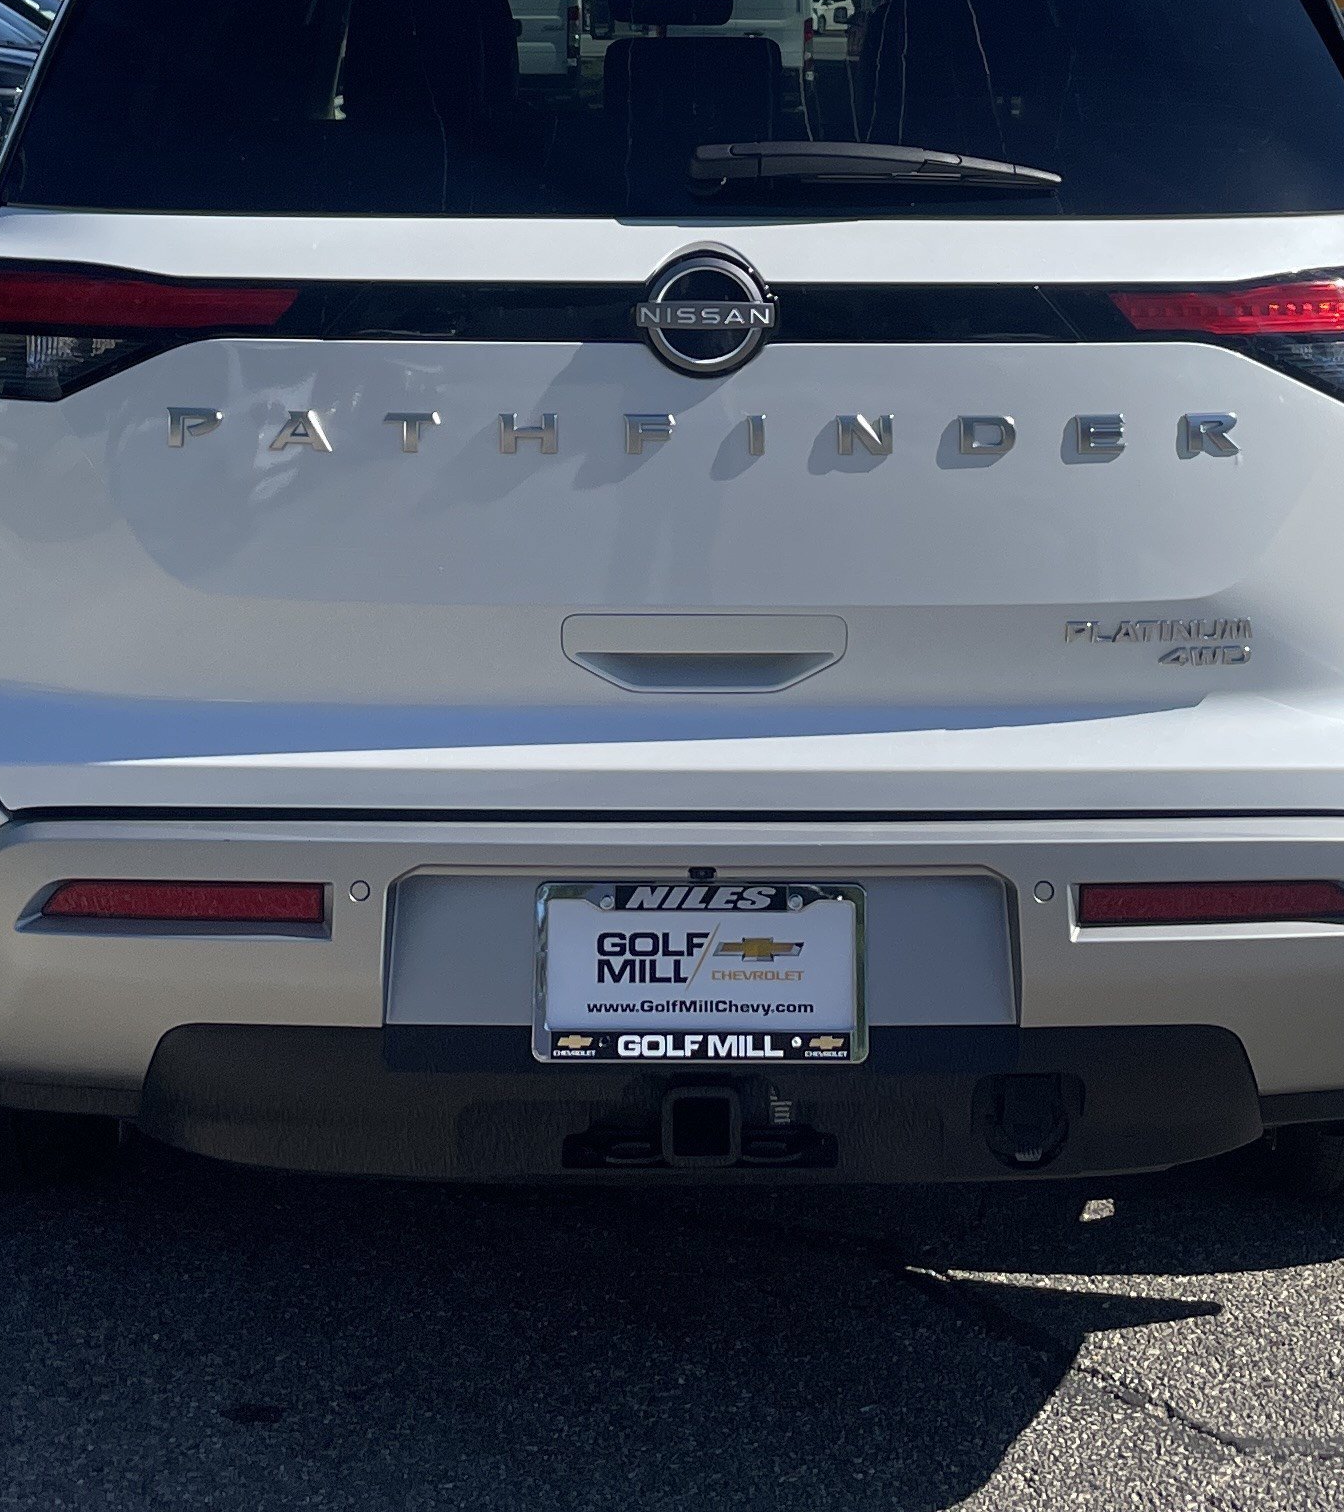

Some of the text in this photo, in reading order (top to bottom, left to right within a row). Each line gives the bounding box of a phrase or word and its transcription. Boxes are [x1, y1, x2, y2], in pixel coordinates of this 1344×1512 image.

[640, 307, 770, 325] NISSAN
[165, 406, 1241, 455] PATHFINDER
[1065, 617, 1253, 643] PLATINUM
[1157, 644, 1252, 667] 4WD
[624, 885, 778, 910] NILES
[596, 931, 711, 957] GOLF
[596, 958, 690, 984] MILL
[711, 970, 805, 982] CHEVROLET
[586, 999, 814, 1016] www.GolfMillChevy.com
[617, 1034, 784, 1057] GOLF MILL
